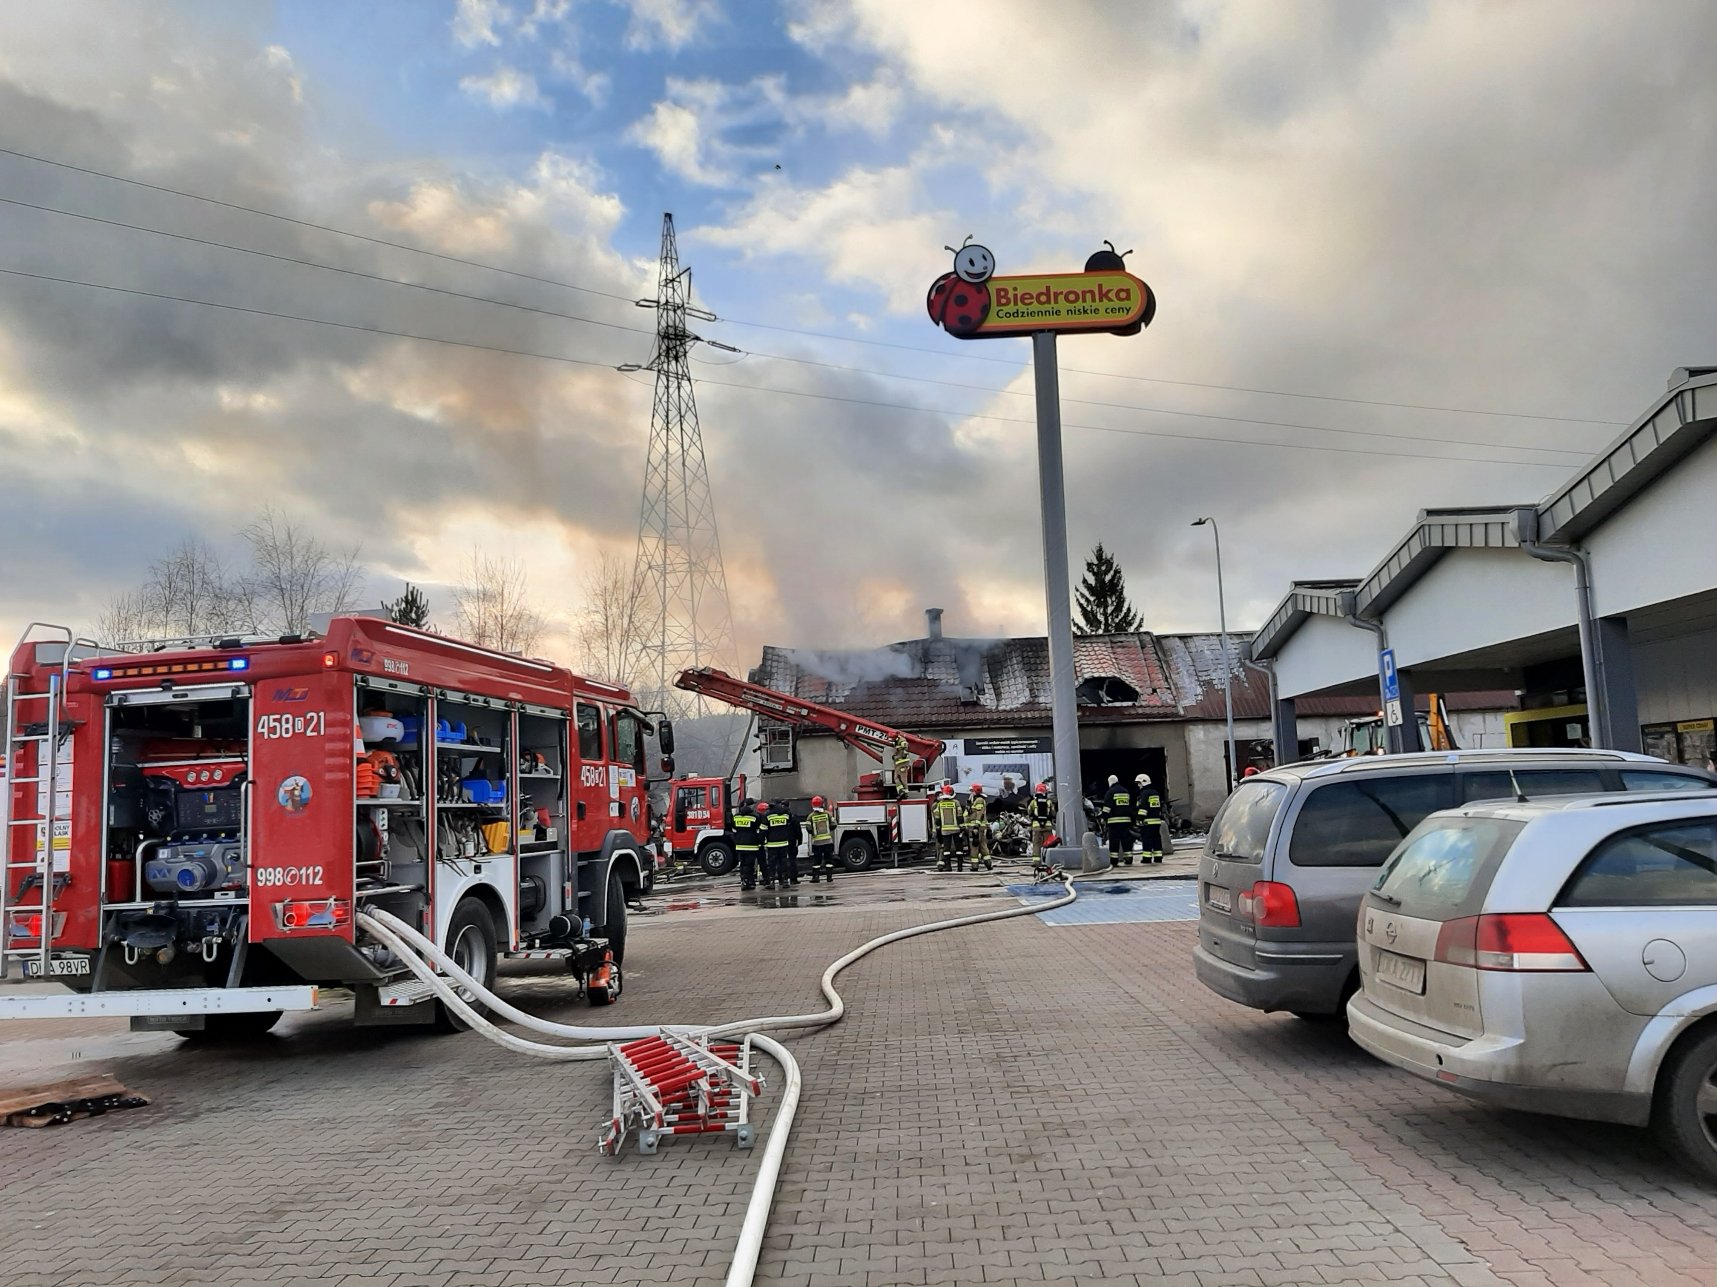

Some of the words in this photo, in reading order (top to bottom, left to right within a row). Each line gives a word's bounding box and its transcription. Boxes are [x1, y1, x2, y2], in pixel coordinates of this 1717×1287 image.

[995, 283, 1131, 307] Biedronka
[996, 307, 1061, 319] Codziennie
[1066, 305, 1100, 316] niskie
[1104, 305, 1132, 315] ceny
[1383, 654, 1393, 687] P
[306, 711, 325, 737] 21
[256, 867, 284, 887] 998
[299, 866, 323, 885] 112
[30, 962, 56, 975] DA
[58, 961, 88, 974] 98VR
